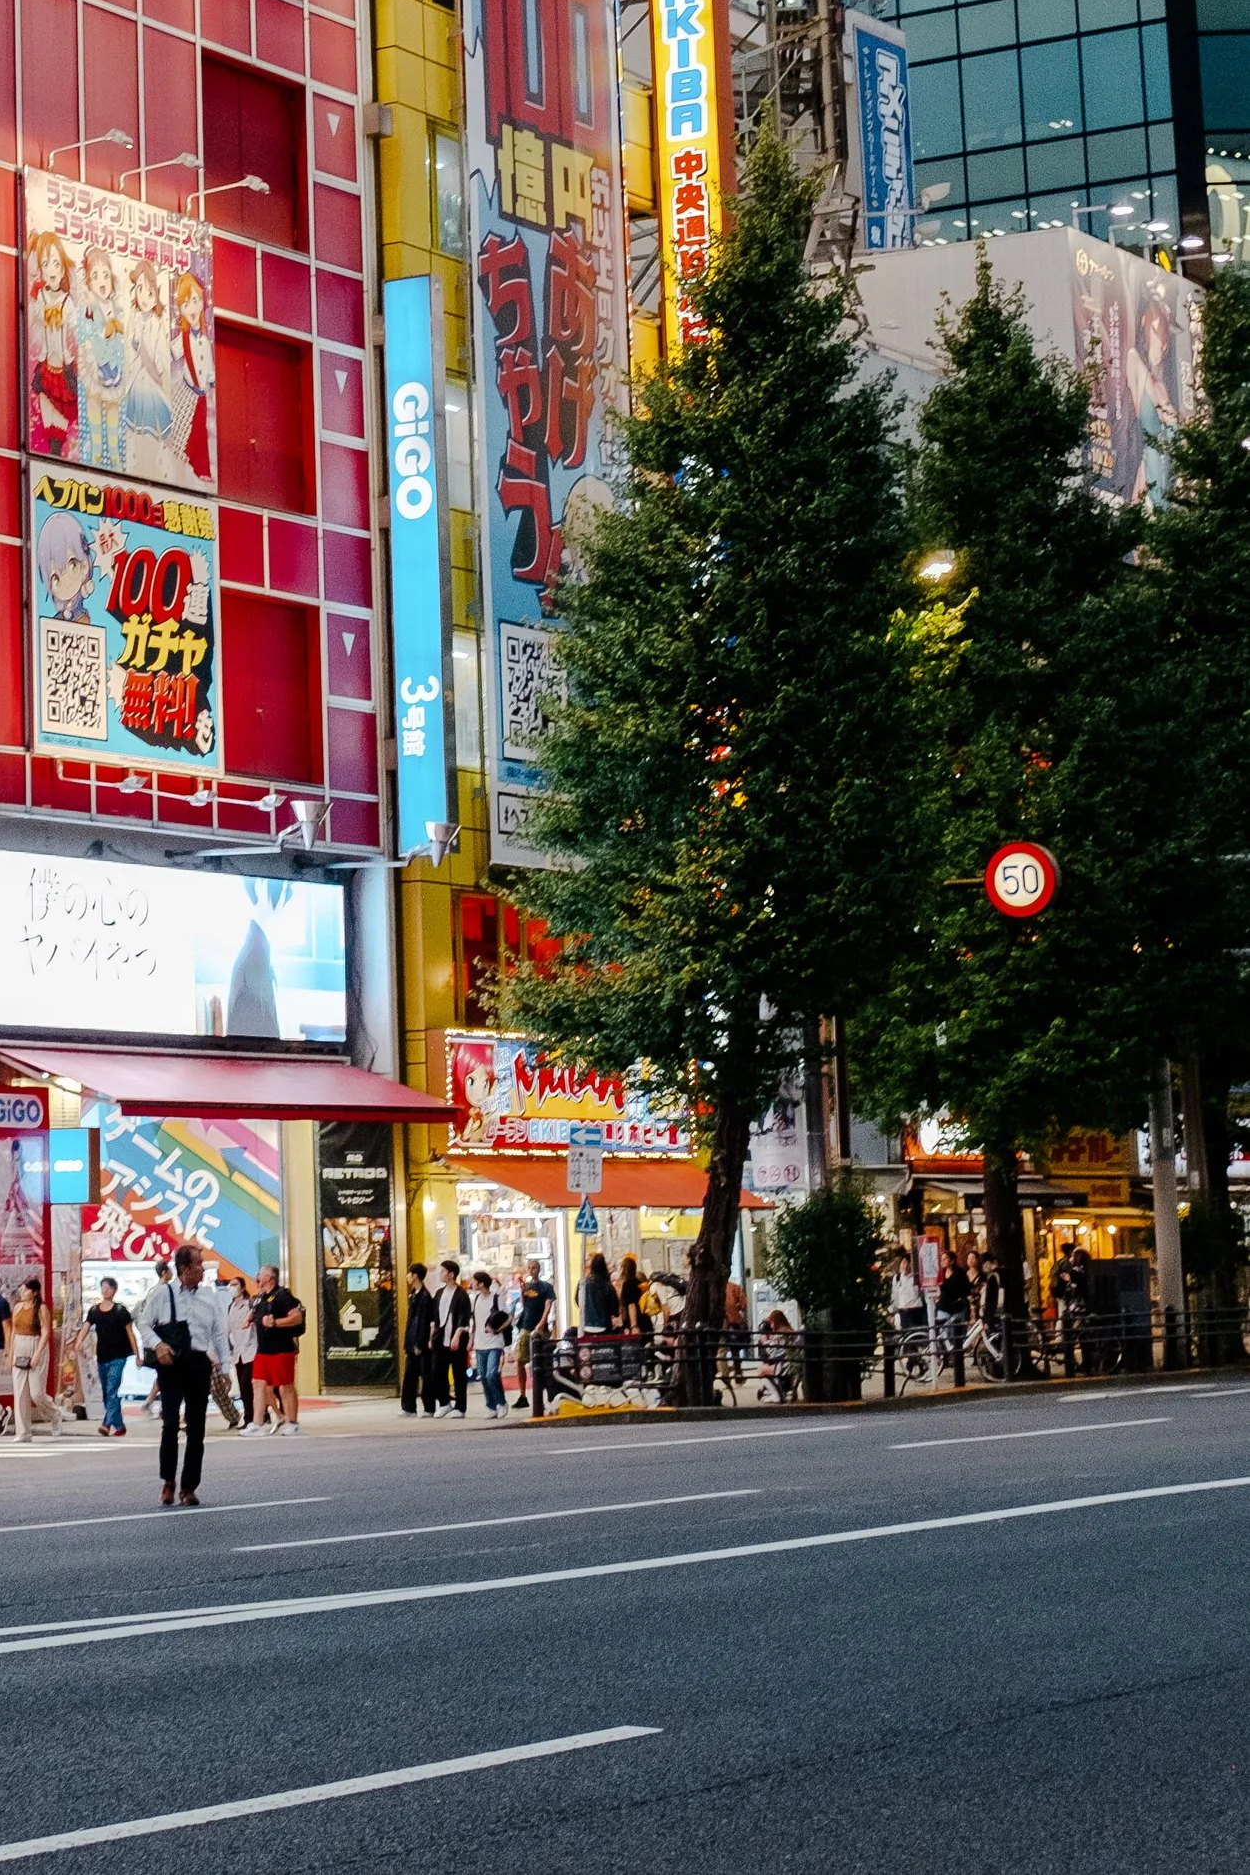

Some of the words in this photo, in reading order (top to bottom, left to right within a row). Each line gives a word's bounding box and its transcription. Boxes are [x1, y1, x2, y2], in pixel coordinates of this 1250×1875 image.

[392, 381, 433, 520] GiGO
[117, 613, 208, 676] ガチャ
[25, 866, 150, 928] 僕の心の
[1001, 864, 1040, 896] 50
